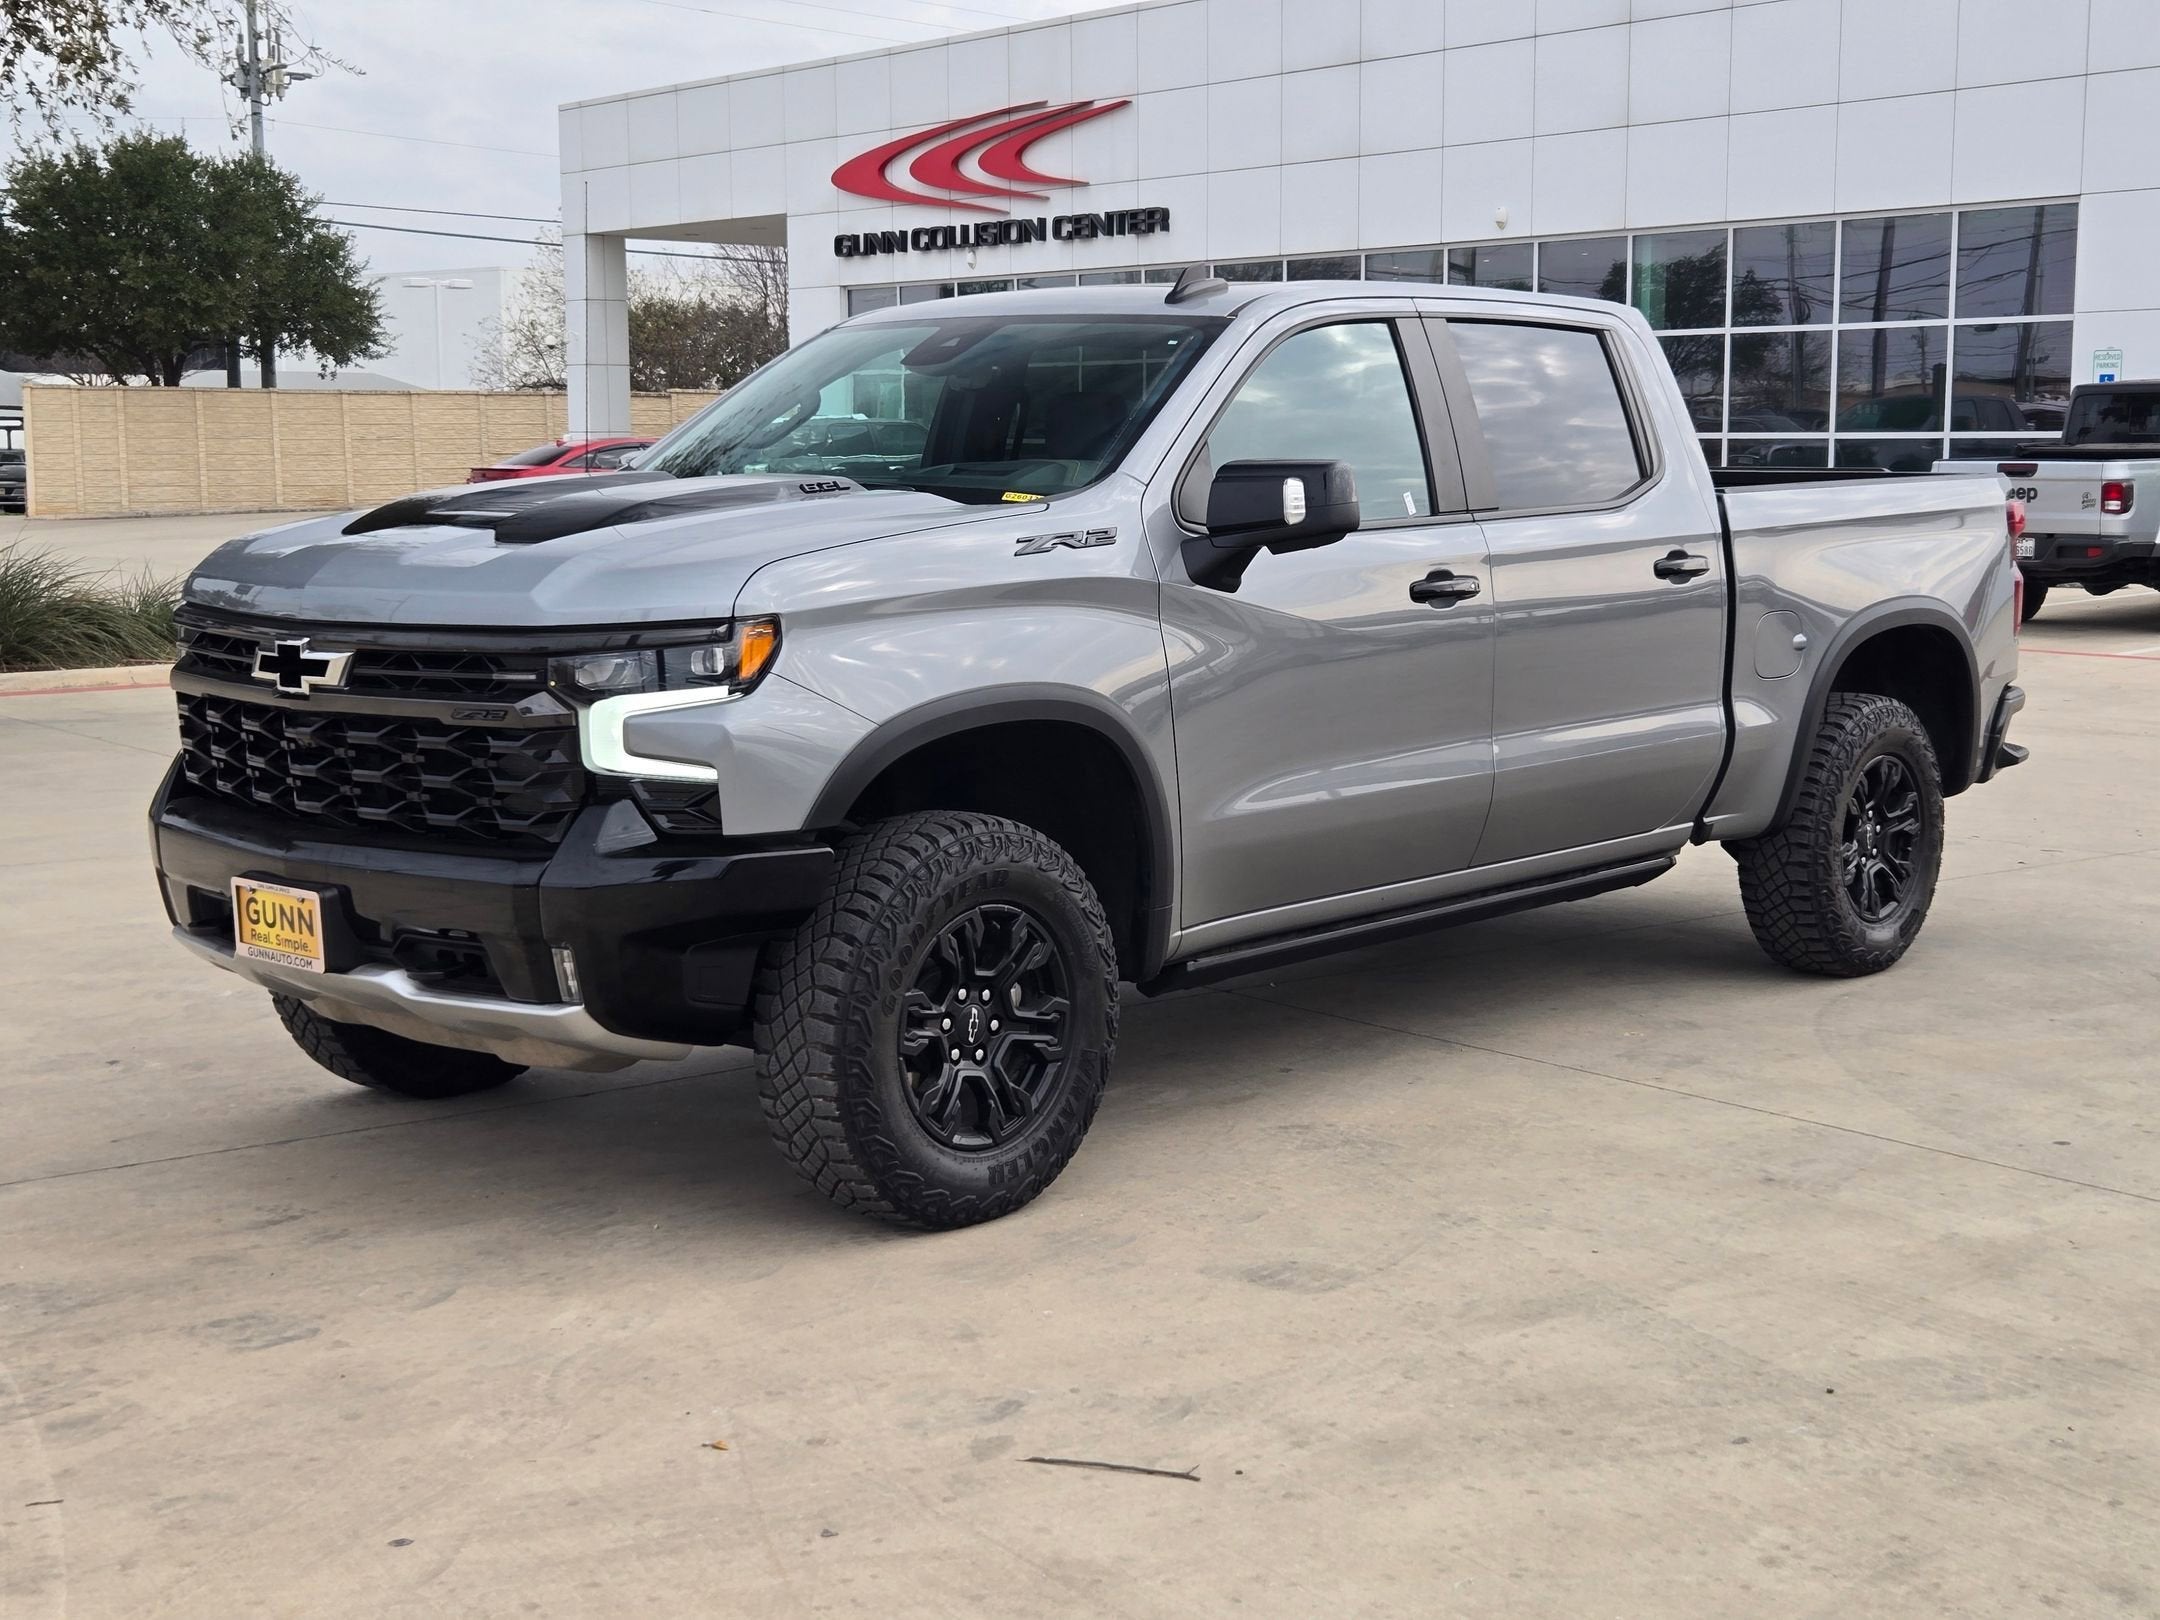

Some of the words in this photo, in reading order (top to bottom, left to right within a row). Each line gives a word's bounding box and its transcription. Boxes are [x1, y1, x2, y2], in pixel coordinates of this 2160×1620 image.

[834, 230, 908, 258] GUNN
[911, 217, 1047, 251] COLLISION
[1052, 206, 1170, 242] CENTER
[1014, 527, 1118, 557] ZR2
[246, 896, 315, 937] GUNN
[251, 928, 273, 945] Real.
[275, 934, 312, 953] Simple.
[247, 946, 313, 969] GUNNAUTO.COM
